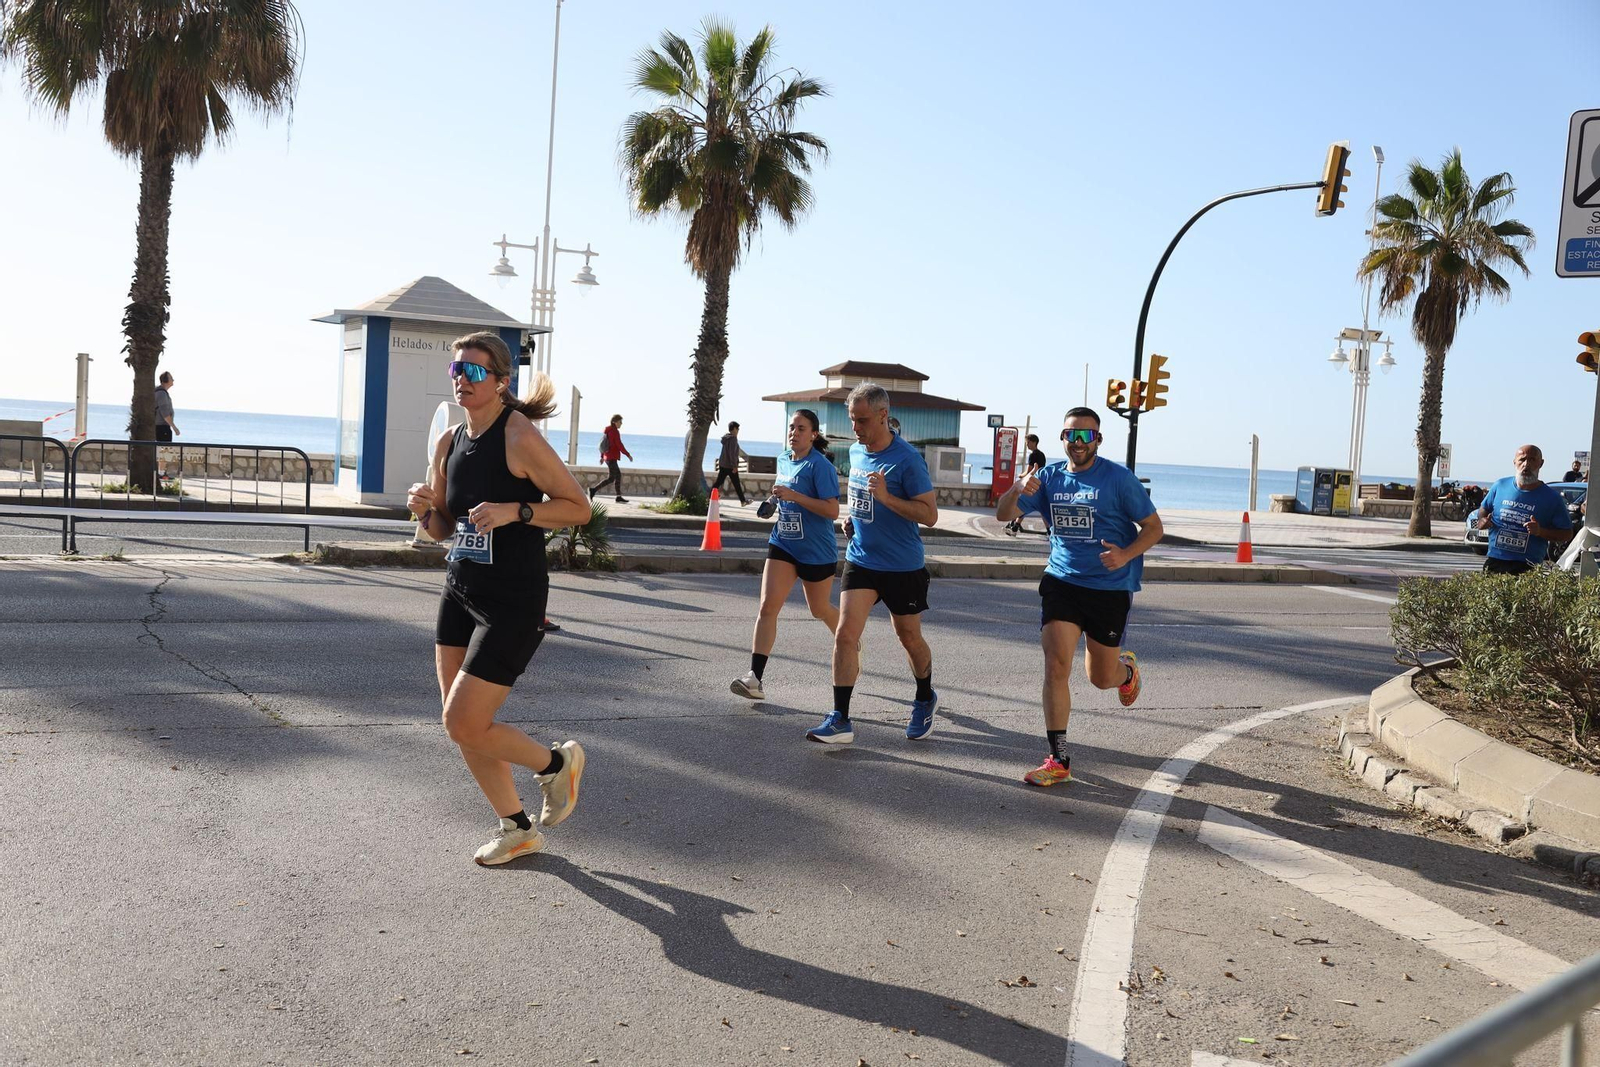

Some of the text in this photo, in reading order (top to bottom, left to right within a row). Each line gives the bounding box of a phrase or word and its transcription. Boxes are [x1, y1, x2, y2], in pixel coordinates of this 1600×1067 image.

[392, 336, 433, 351] Helados
[1053, 489, 1100, 504] mayoral
[1502, 499, 1536, 511] mayoral
[1056, 516, 1088, 527] 2154
